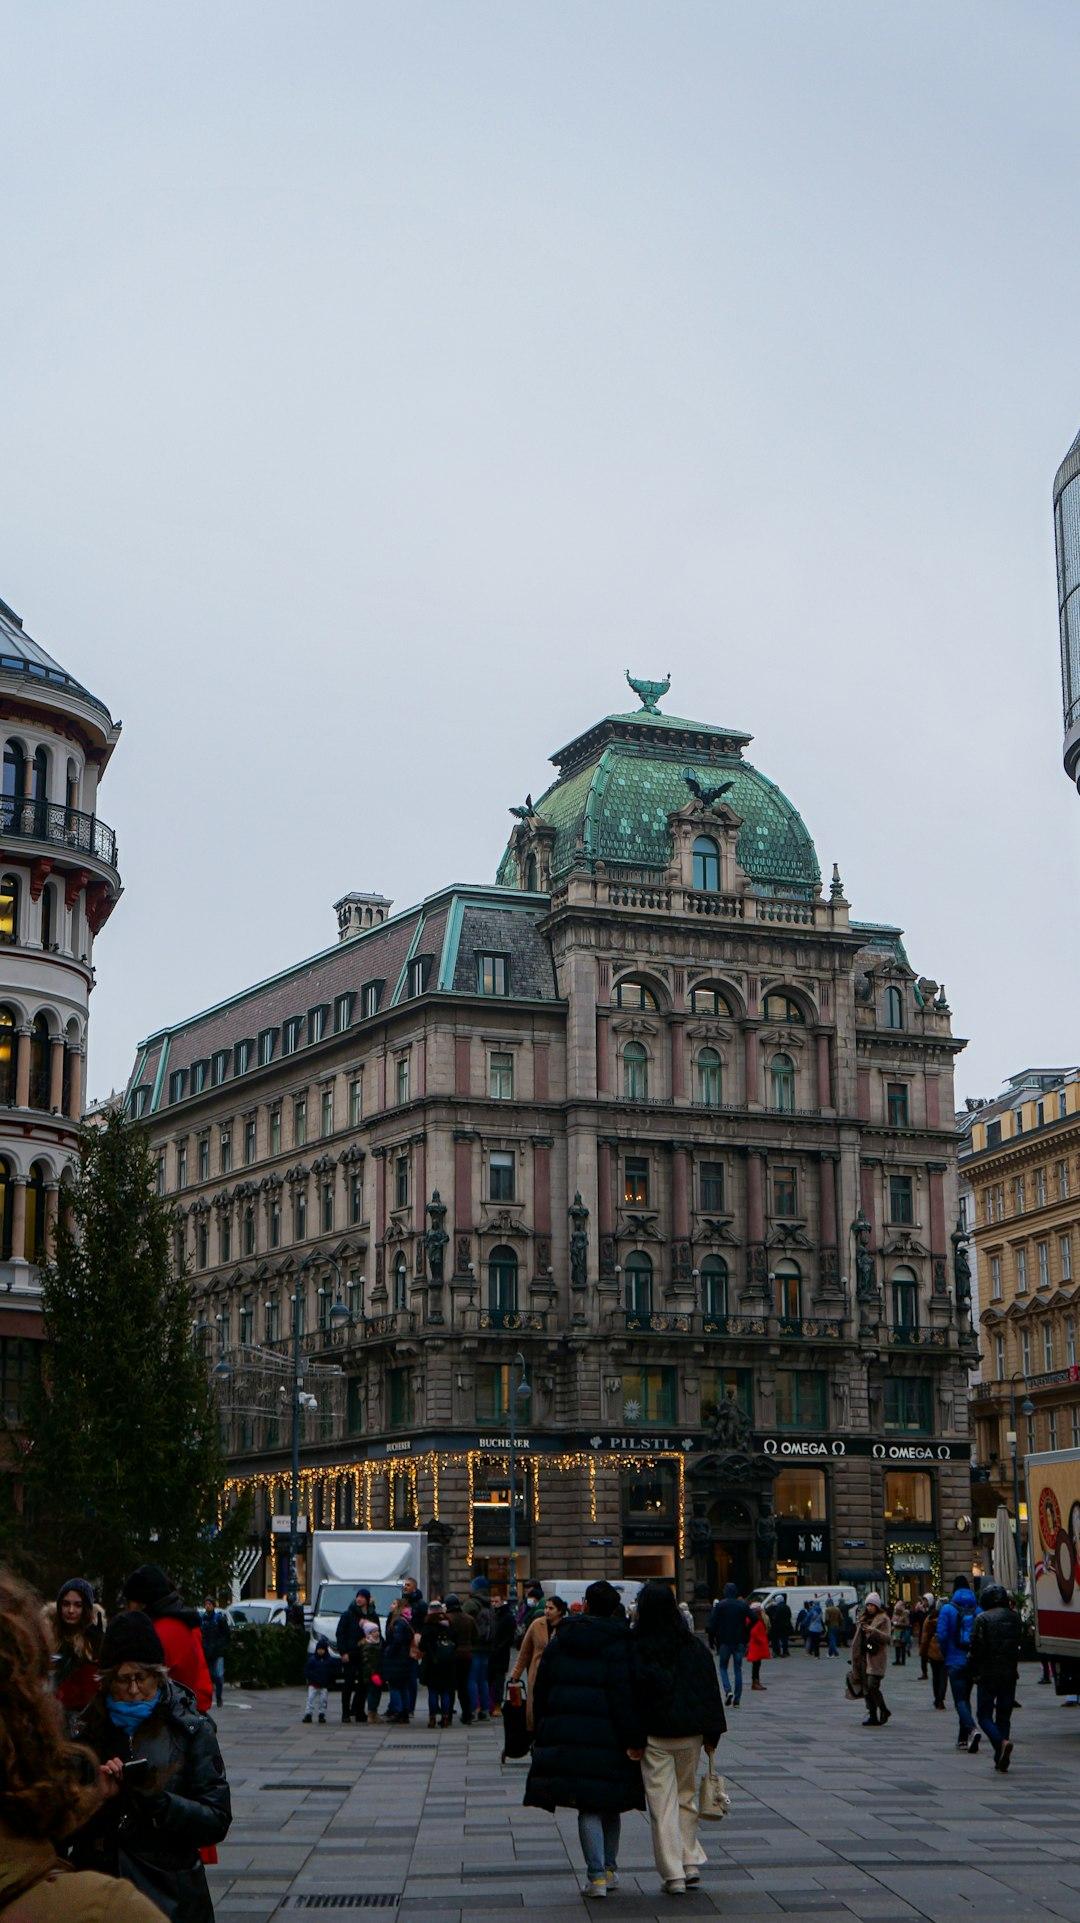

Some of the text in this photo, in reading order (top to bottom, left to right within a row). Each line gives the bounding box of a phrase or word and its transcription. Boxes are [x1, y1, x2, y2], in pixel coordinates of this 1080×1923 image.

[479, 1438, 530, 1449] BUCHERER
[609, 1437, 675, 1450] PILSTL
[780, 1442, 828, 1456] OMEGA
[888, 1446, 933, 1460] OMEGA
